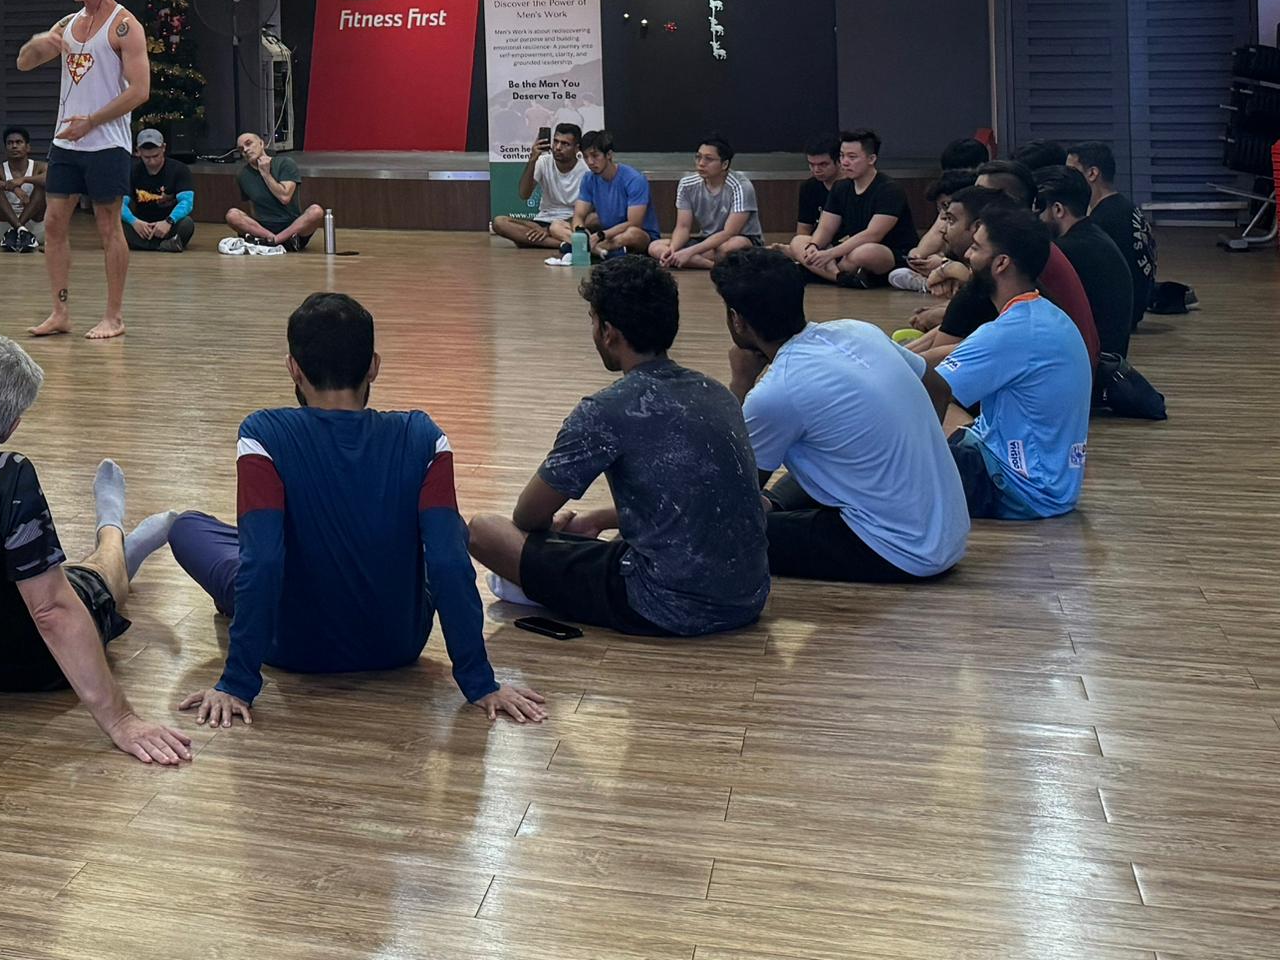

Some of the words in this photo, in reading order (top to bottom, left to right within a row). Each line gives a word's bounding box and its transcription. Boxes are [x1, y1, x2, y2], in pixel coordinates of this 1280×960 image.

[494, 0, 530, 8] Discover
[533, 0, 546, 7] the
[339, 9, 403, 30] Fitness
[407, 8, 447, 29] First
[517, 11, 542, 19] Men's
[544, 10, 568, 18] Work
[508, 80, 520, 88] Be
[522, 80, 537, 88] the
[538, 79, 559, 88] Man
[561, 79, 580, 88] You
[512, 92, 550, 100] Deserve
[552, 91, 563, 100] To
[565, 91, 577, 99] Be
[500, 145, 520, 153] Scan
